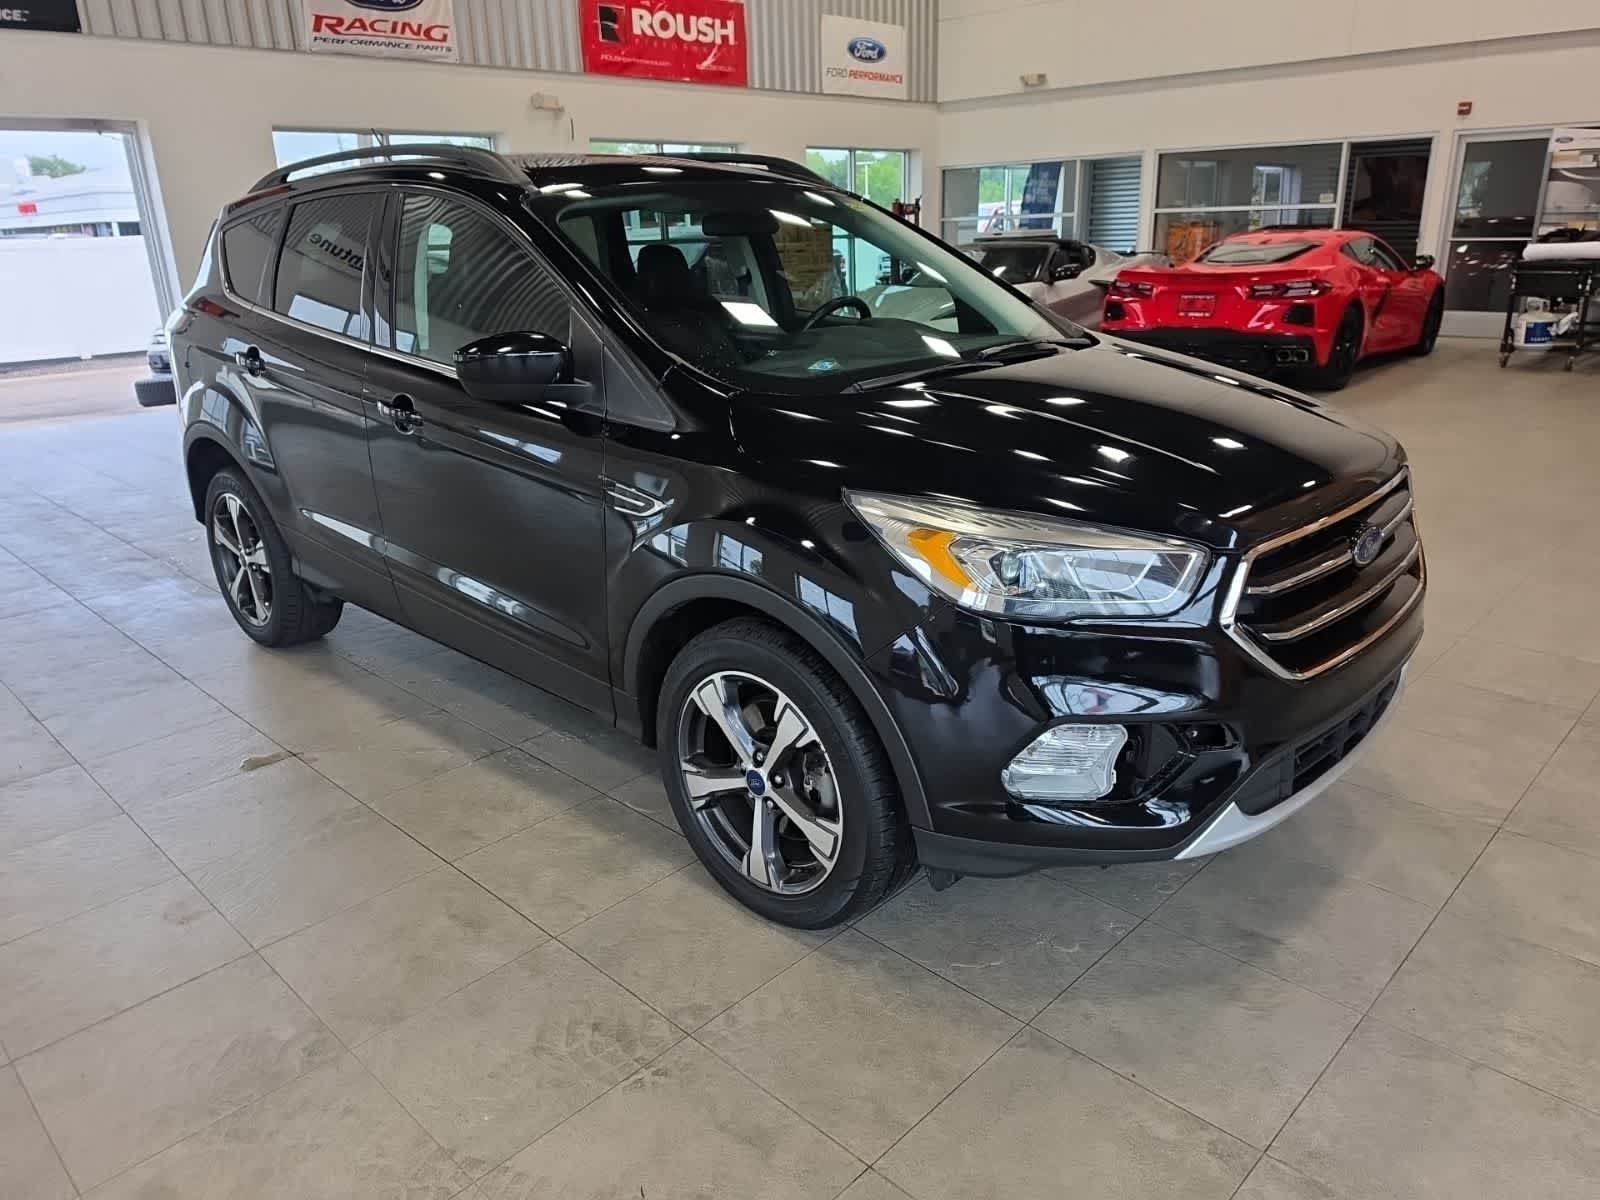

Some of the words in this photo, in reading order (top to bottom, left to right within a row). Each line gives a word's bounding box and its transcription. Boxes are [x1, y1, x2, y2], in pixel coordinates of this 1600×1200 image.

[312, 14, 449, 42] RACING
[631, 7, 735, 45] ROUSH
[313, 36, 413, 49] PERFORMANCE
[416, 44, 452, 52] PARTS
[854, 40, 880, 59] Ford
[826, 66, 848, 78] FORD
[848, 69, 903, 84] PERFORMANCE
